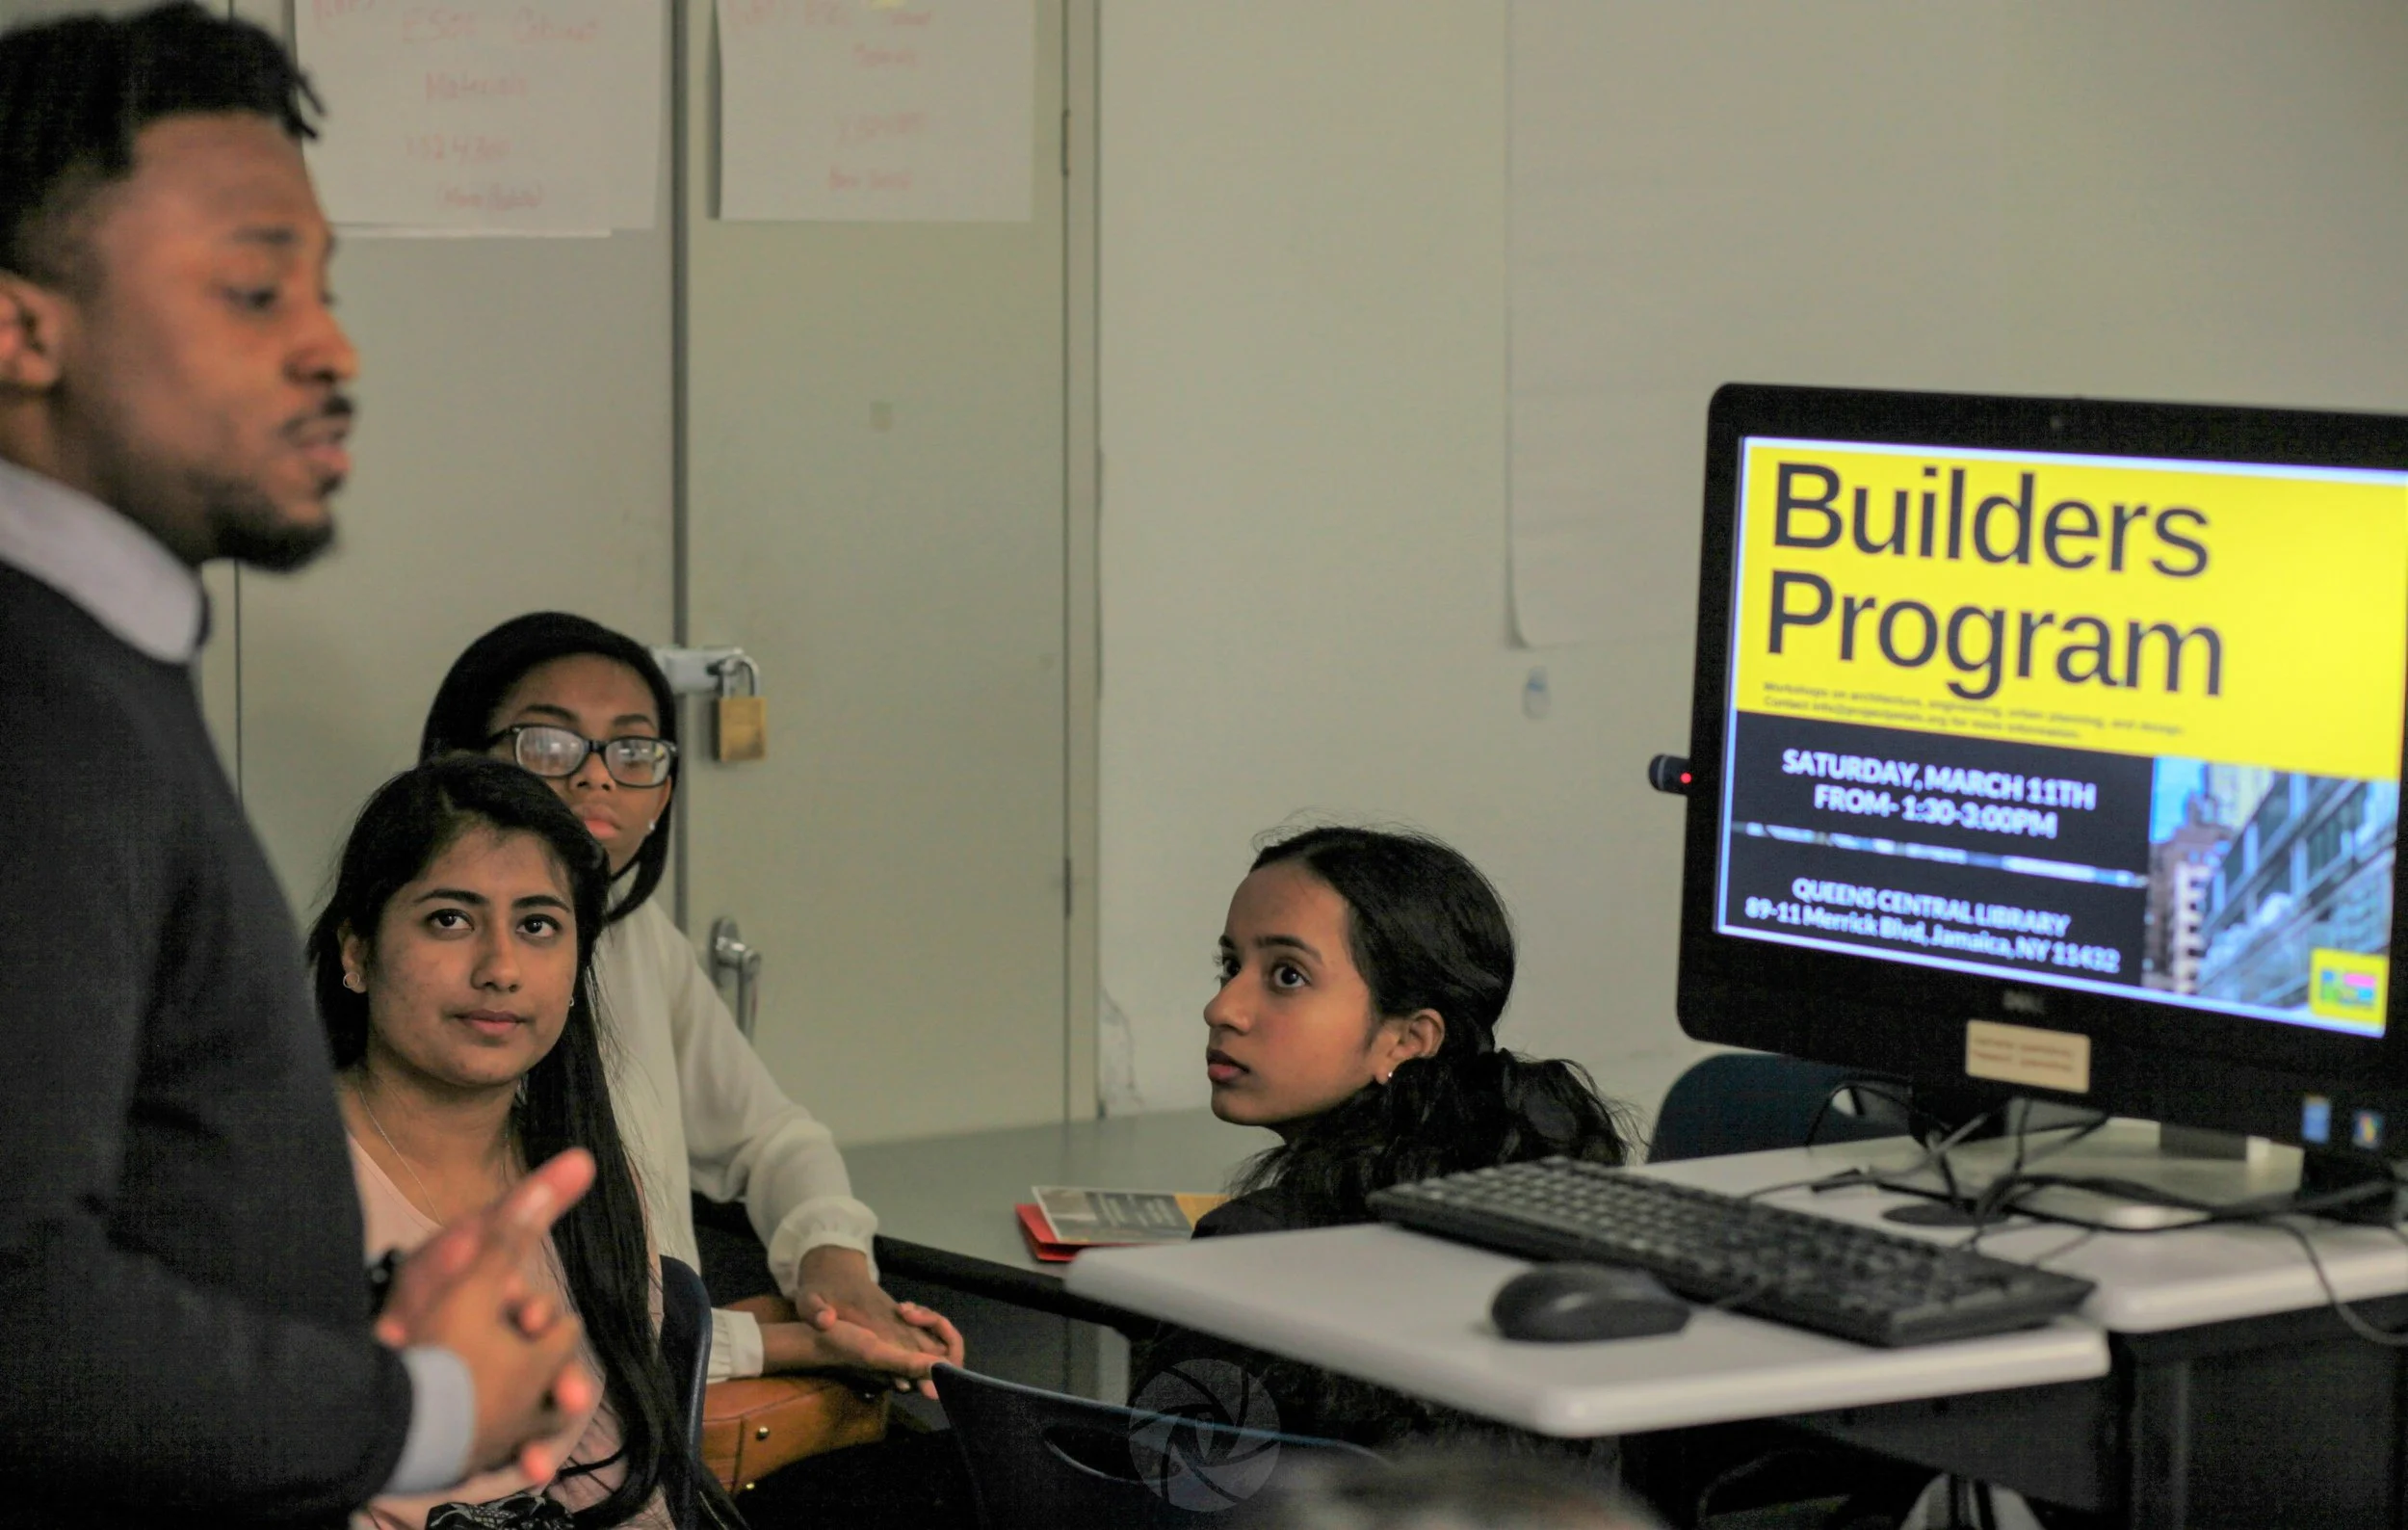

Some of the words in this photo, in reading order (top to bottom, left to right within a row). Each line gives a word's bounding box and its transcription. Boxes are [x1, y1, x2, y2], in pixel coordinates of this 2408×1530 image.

[1772, 461, 2211, 578] Builders
[1766, 568, 2224, 700] Program
[1782, 749, 1924, 792] SATURDAY,
[1924, 765, 2026, 802] MARCH
[2026, 777, 2097, 810] 11TH
[1744, 896, 1801, 925] 89-11
[1801, 905, 1877, 936] Merrick
[1929, 923, 2015, 960] Jamaica,
[2015, 936, 2052, 963] NY
[1792, 877, 1877, 910] QUEENS
[1877, 889, 1975, 925] CENTRAL
[1975, 902, 2072, 937] LIBRARY
